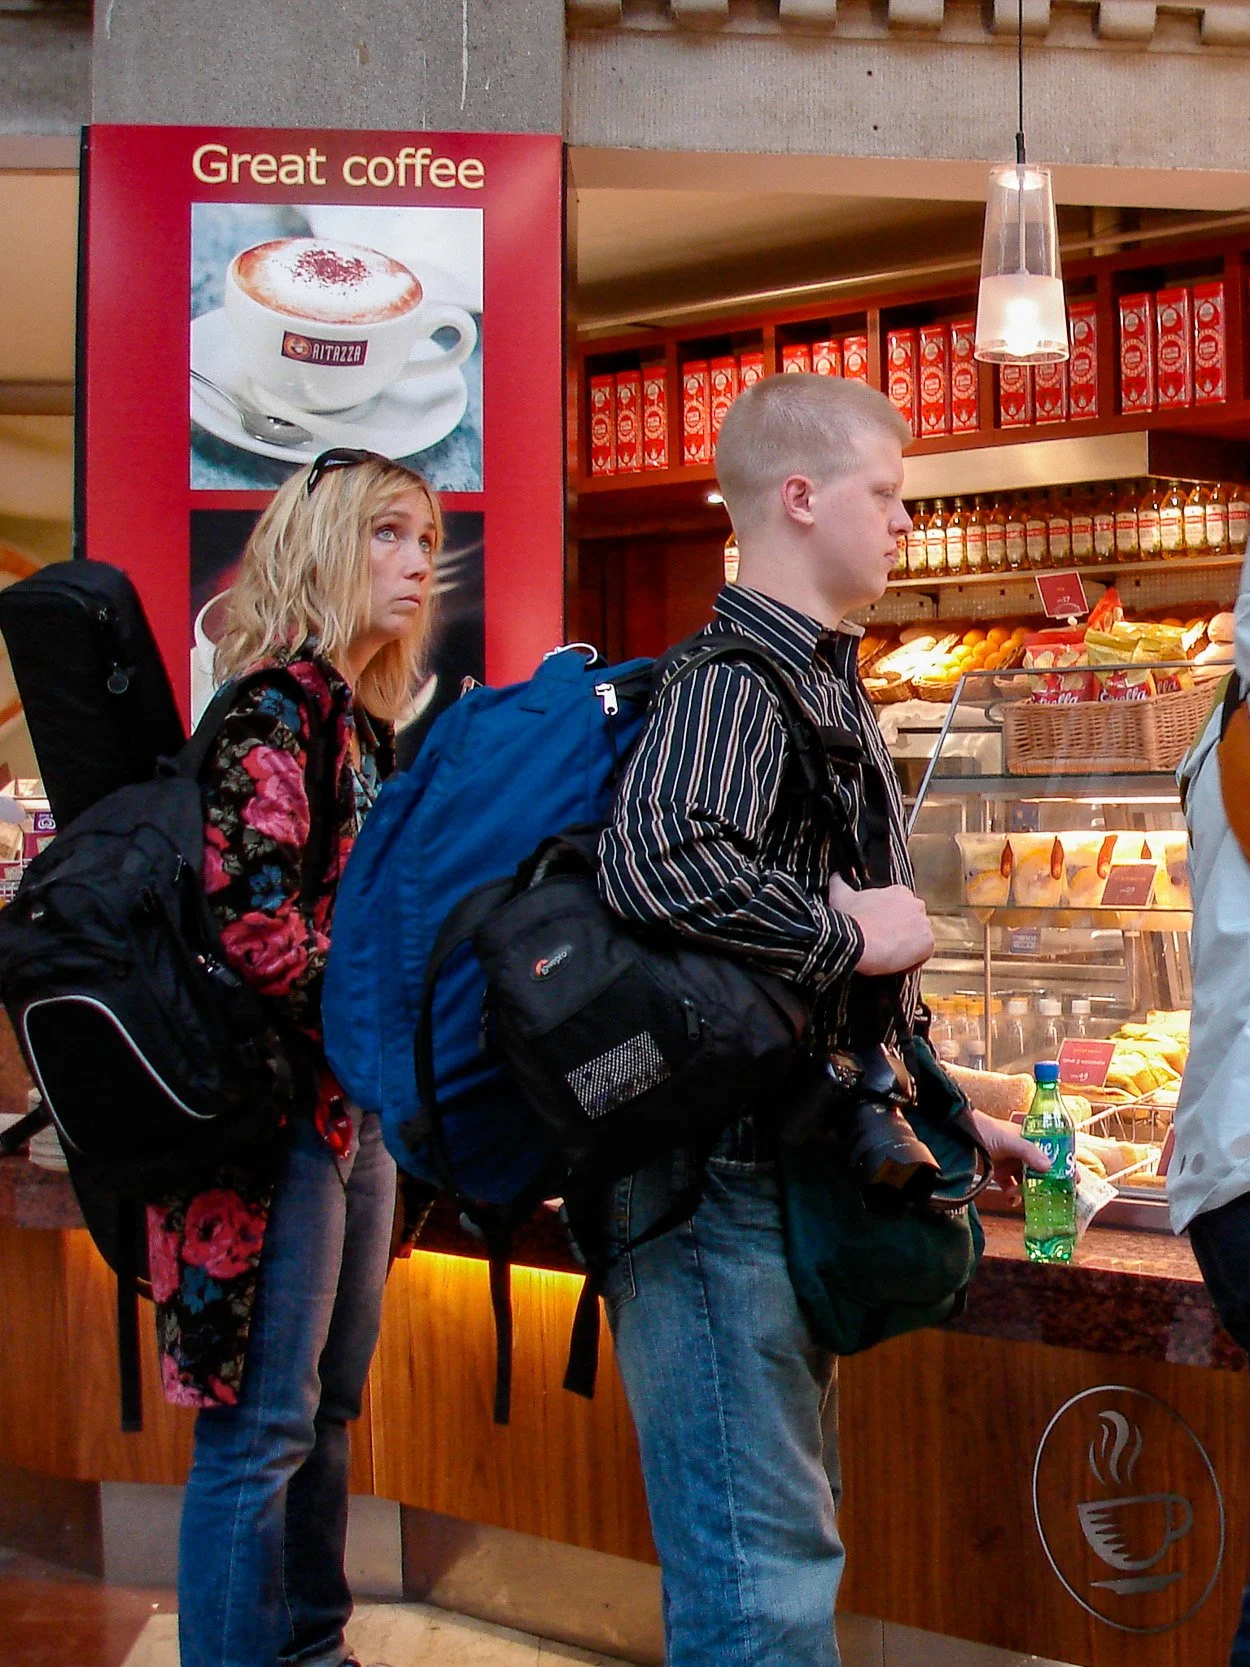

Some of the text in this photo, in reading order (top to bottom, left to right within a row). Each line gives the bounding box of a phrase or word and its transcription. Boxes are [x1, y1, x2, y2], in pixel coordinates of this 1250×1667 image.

[192, 143, 485, 189] Great coffee
[312, 343, 361, 362] RITAZZA
